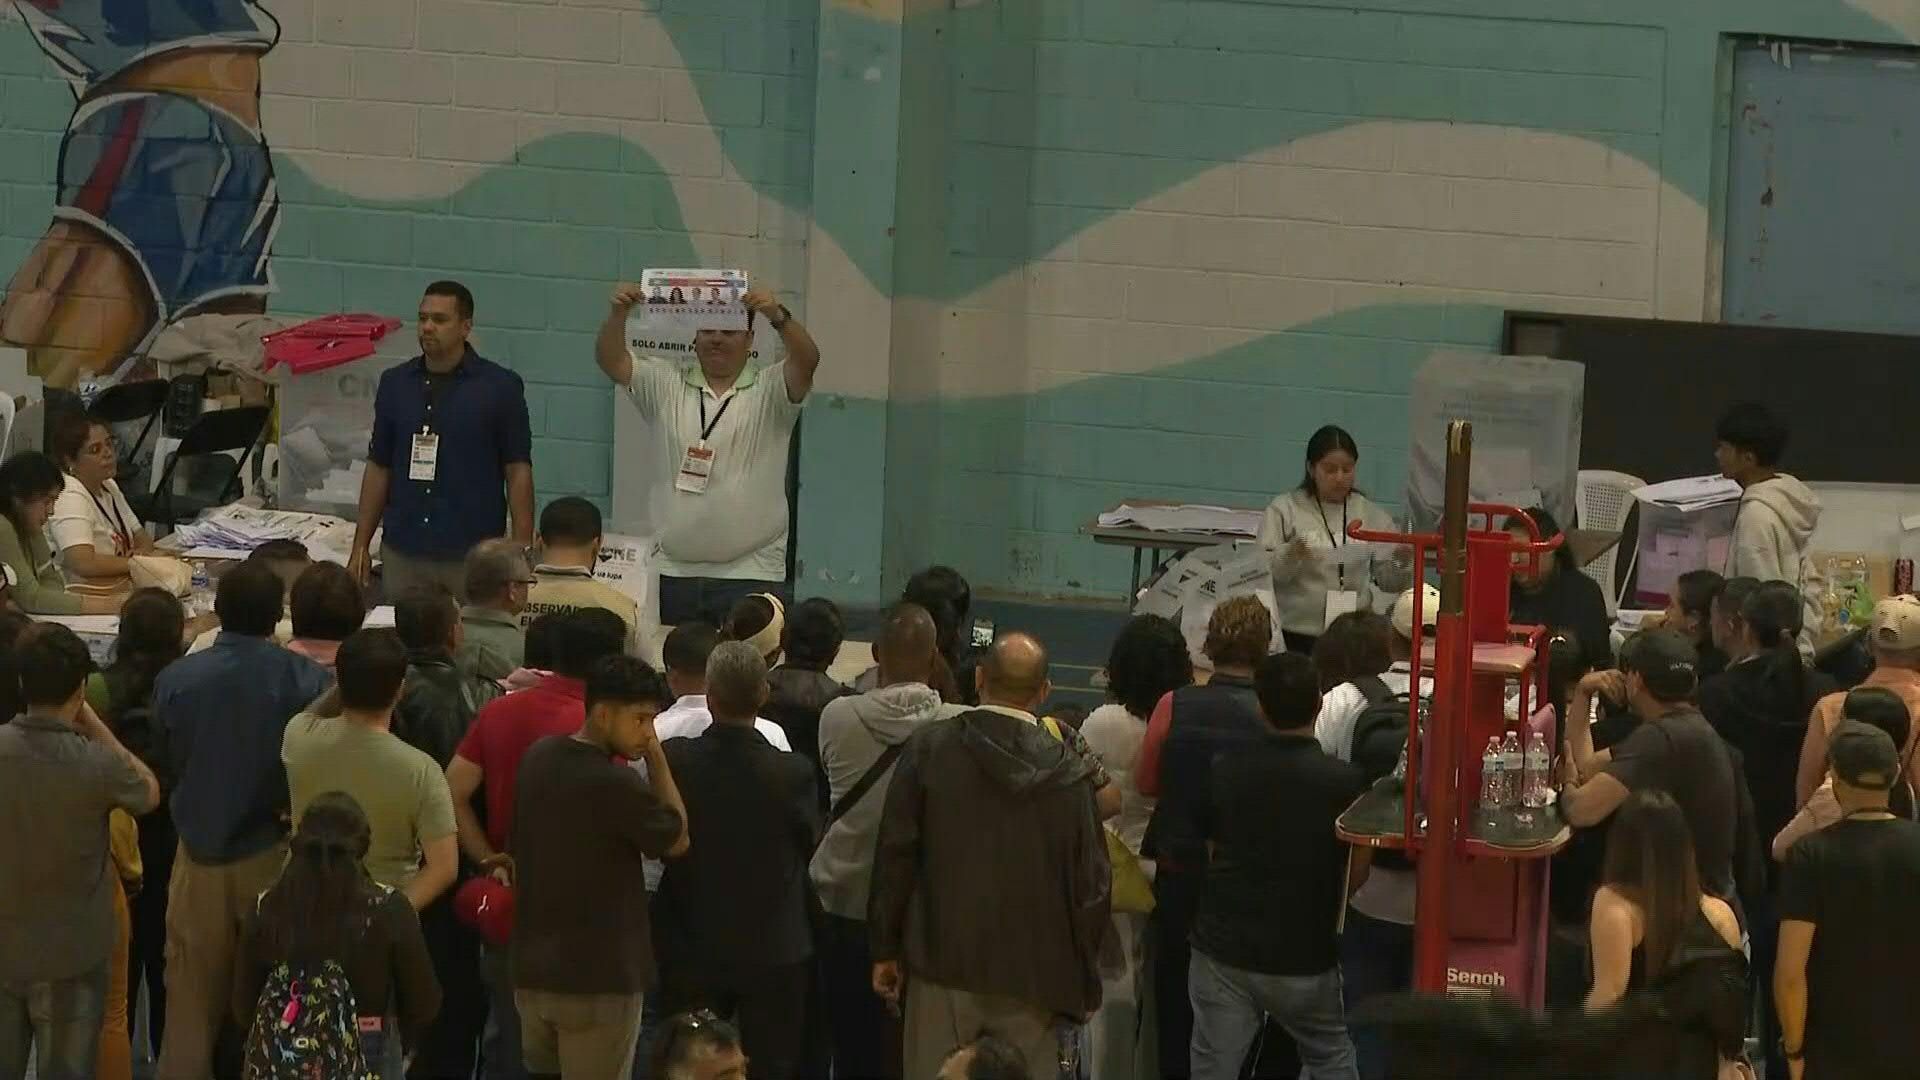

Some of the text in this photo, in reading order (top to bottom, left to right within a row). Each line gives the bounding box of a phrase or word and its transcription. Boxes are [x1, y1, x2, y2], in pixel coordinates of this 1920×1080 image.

[632, 339, 656, 349] SOLO
[659, 341, 686, 352] ABRIR
[520, 602, 577, 616] BSERVA
[1447, 967, 1505, 986] Senoh
